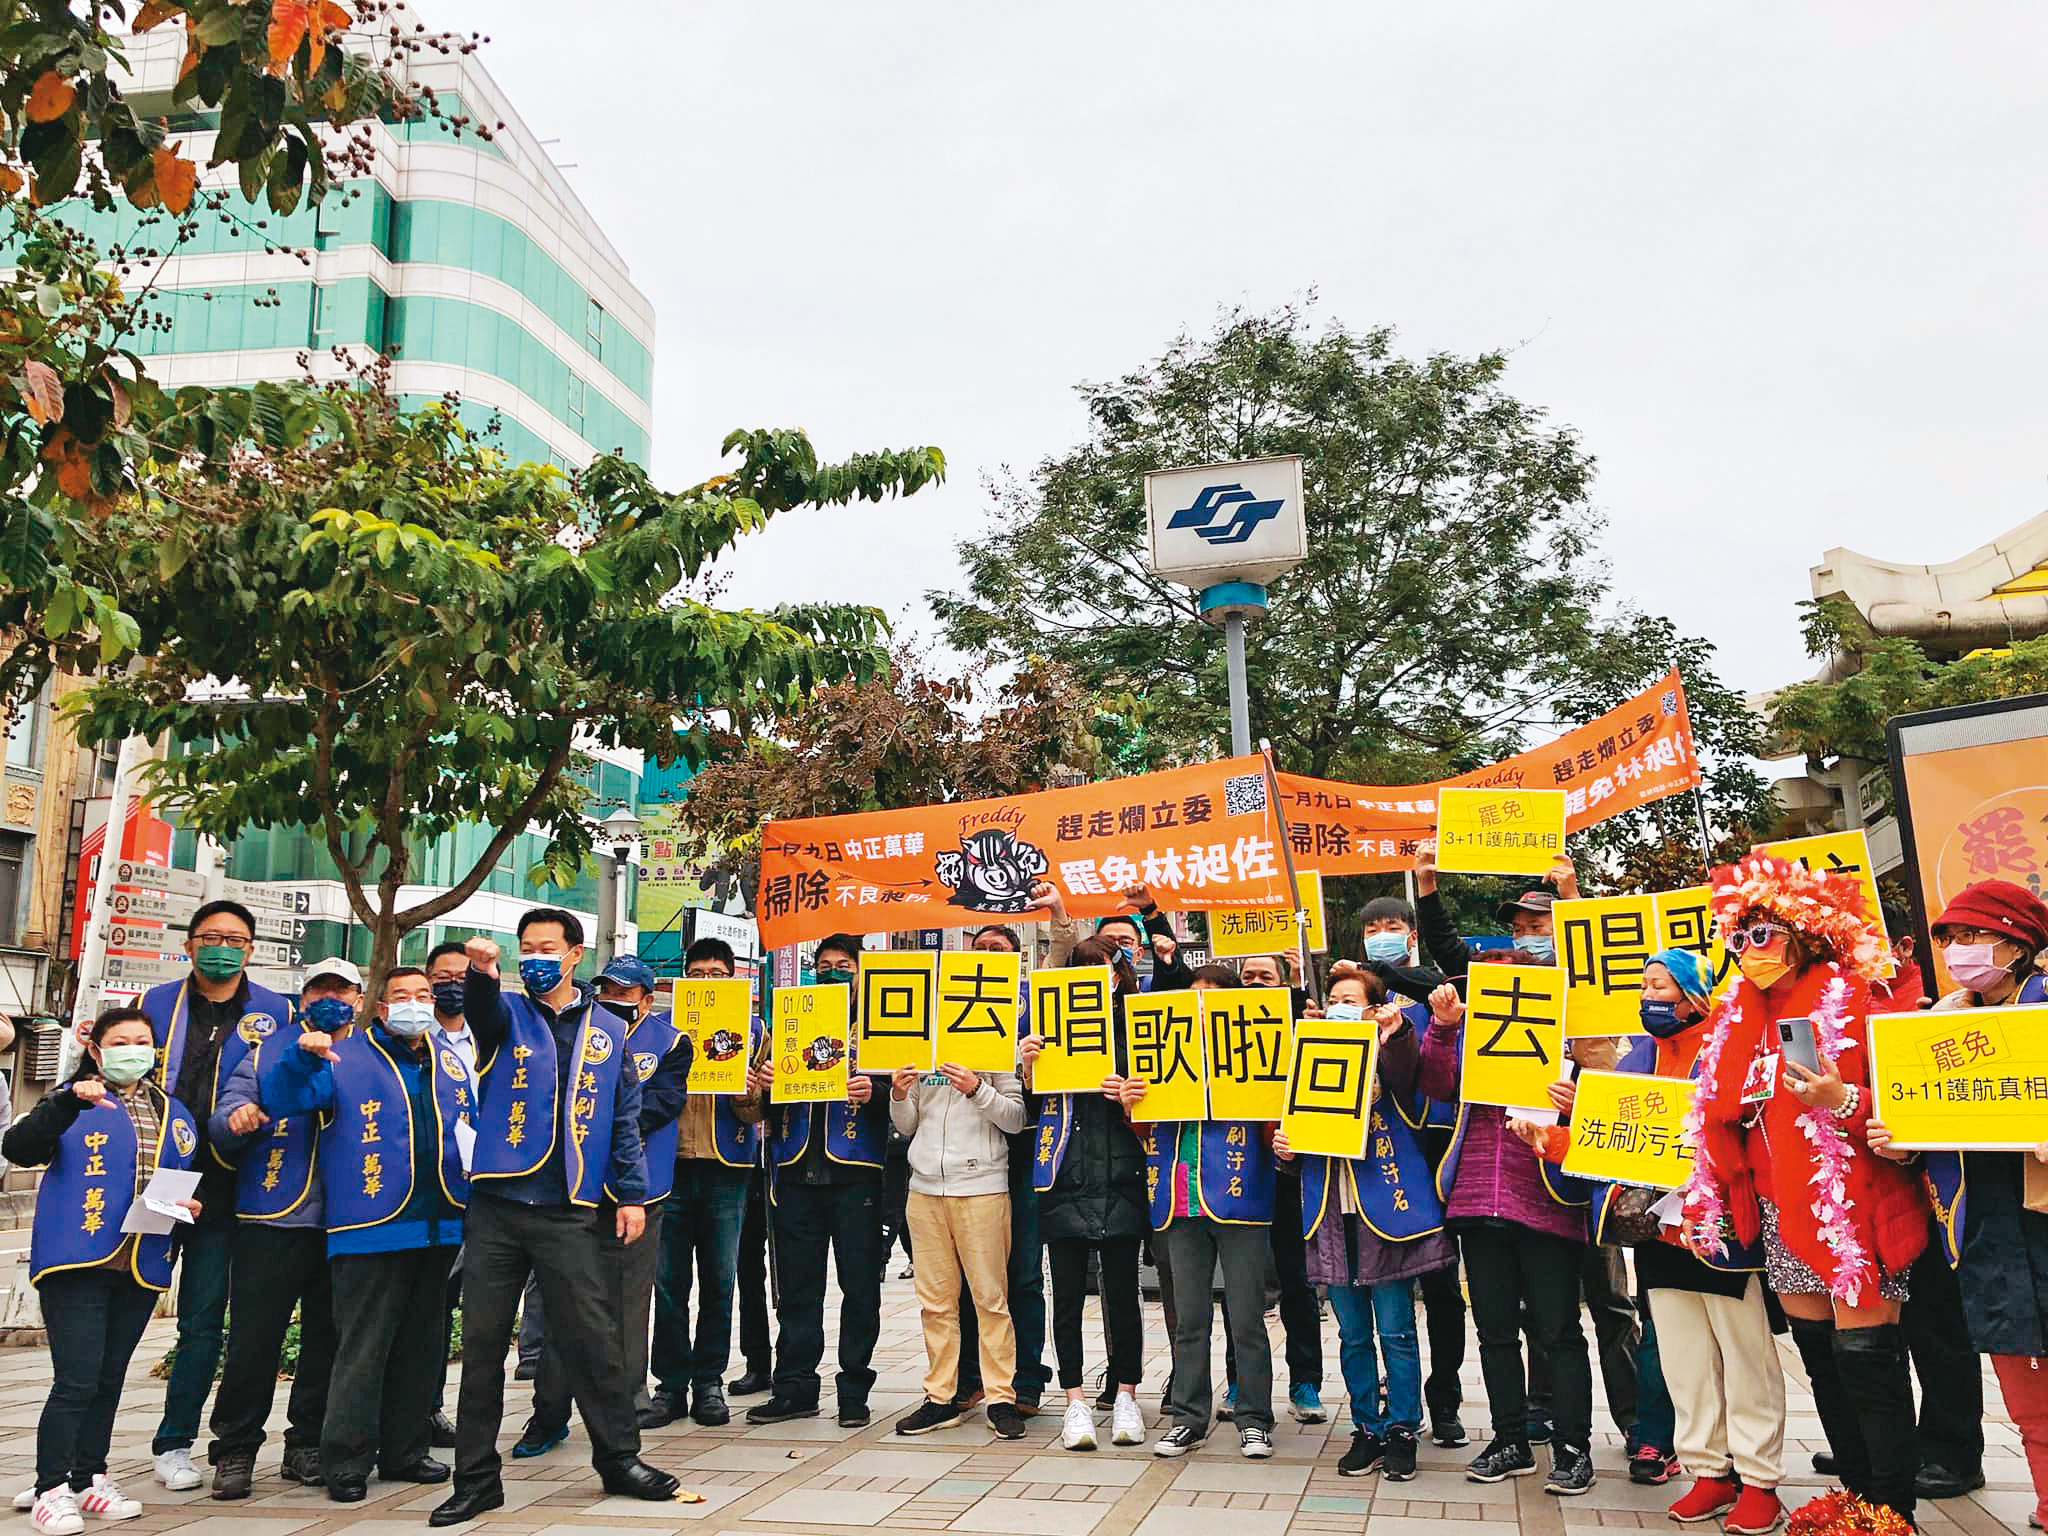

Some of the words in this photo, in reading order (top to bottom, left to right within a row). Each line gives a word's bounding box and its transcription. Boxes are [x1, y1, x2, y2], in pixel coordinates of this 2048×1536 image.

[1553, 713, 1656, 784] 趕走爛立委
[958, 805, 1028, 833] Freddy
[1056, 794, 1212, 842] 趕走爛立委
[1281, 791, 1351, 809] 一月九日
[1357, 799, 1437, 814] 中正萬華
[1478, 800, 1525, 828] 罷免
[765, 841, 843, 862] 一月九日
[845, 832, 925, 862] 中正萬華
[1287, 822, 1351, 857] 掃除
[1445, 832, 1558, 849] 3+11護航真相
[1958, 806, 2048, 874] 罷
[1059, 835, 1279, 896] 罷免林昶佐
[764, 869, 832, 920] 掃除
[1564, 912, 1650, 996] 唱
[863, 968, 931, 1041] 回
[943, 963, 1012, 1039] 去
[1038, 980, 1107, 1057] 唱
[1473, 976, 1556, 1066] 去
[784, 1018, 799, 1053] 同意
[1132, 1006, 1198, 1084] 歌
[1210, 1004, 1288, 1084] 啦
[1930, 1030, 1995, 1074] 罷免
[688, 1071, 734, 1083] 免作秀民代
[783, 1080, 837, 1096] 罷免作秀民代
[1288, 1037, 1370, 1120] 回
[1891, 1075, 2048, 1102] 3+11護航真相
[1618, 1091, 1668, 1122] 罷免
